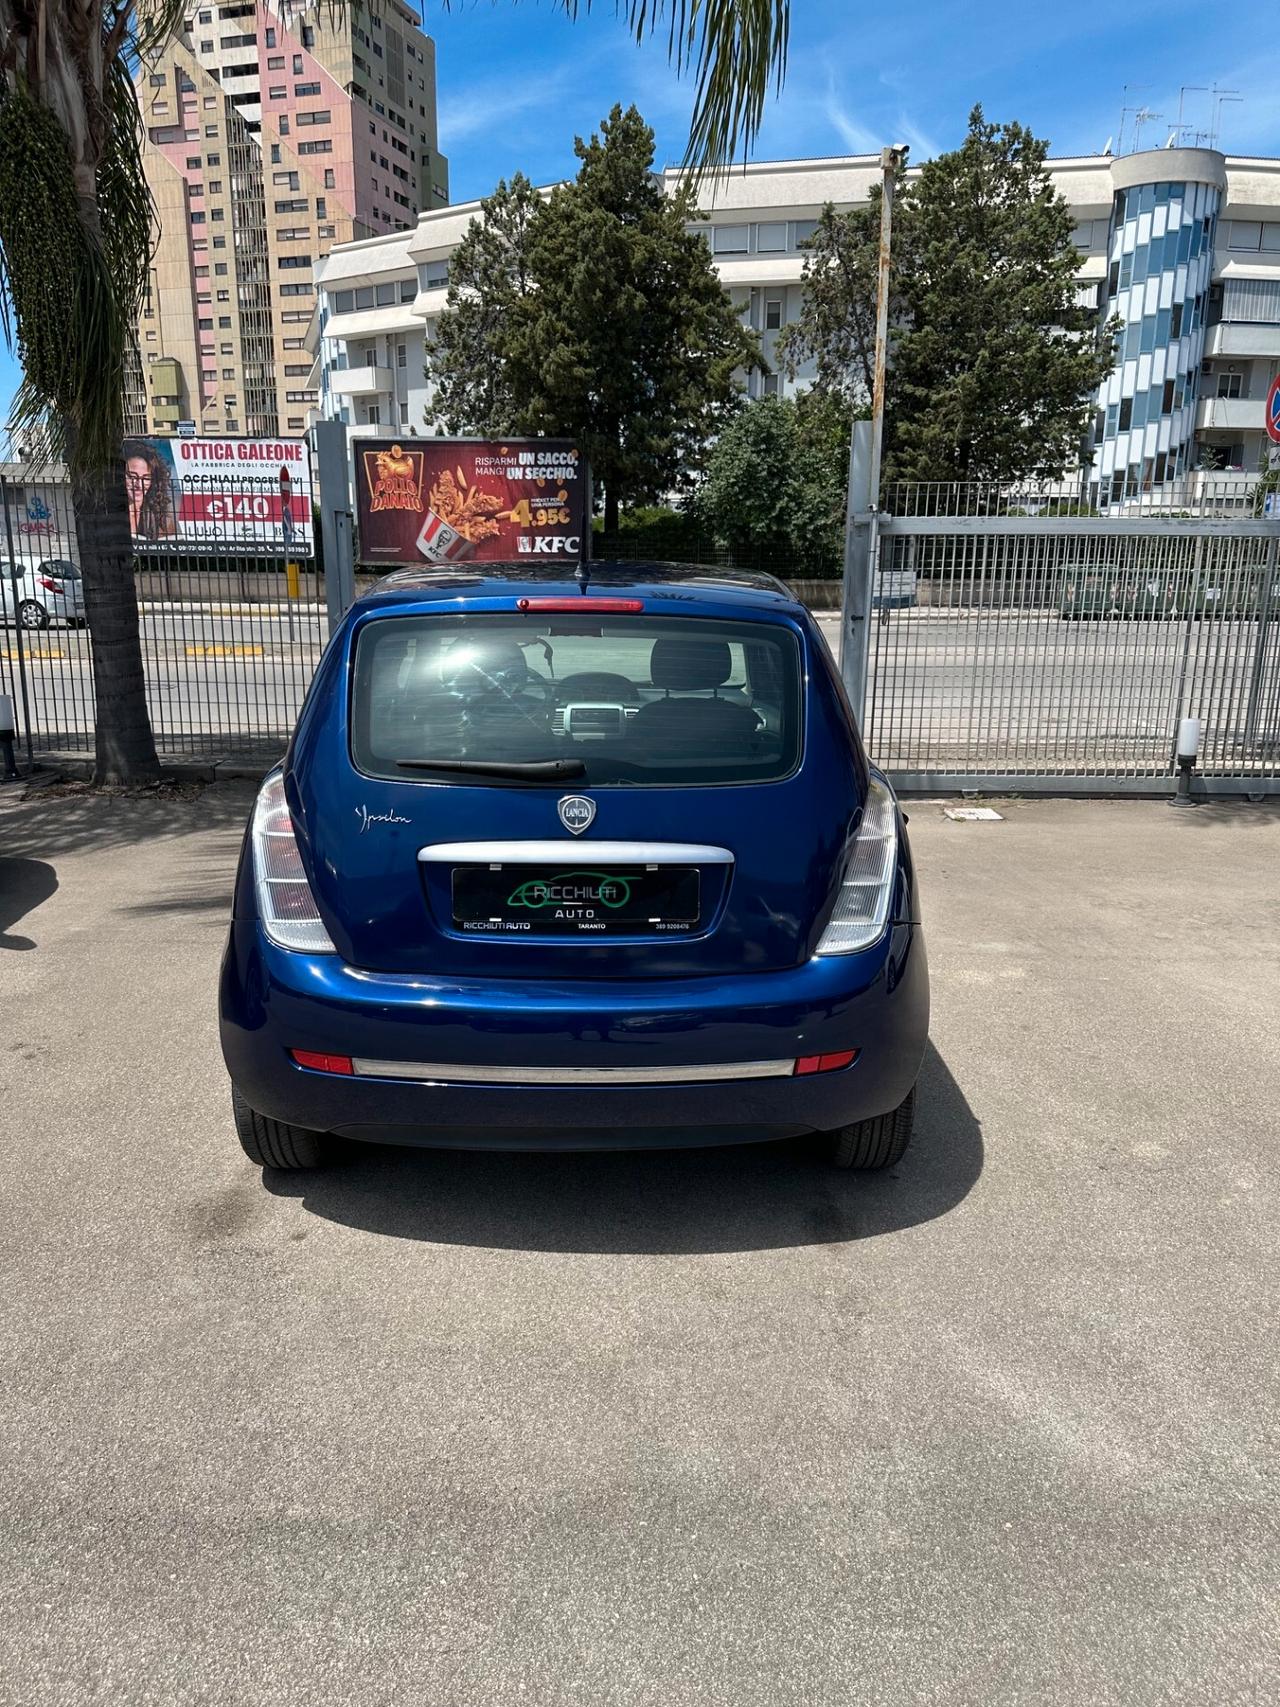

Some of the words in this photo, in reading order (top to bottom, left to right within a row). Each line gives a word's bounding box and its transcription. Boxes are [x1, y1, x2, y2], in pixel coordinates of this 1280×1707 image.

[181, 443, 235, 460] OTTICA
[237, 444, 303, 461] GALEONE
[475, 457, 517, 466] RISPARMI
[518, 452, 535, 465] UN
[183, 474, 240, 484] OCCHIALI
[242, 476, 303, 485] PROGREIVI
[475, 467, 505, 476] MANGI
[506, 467, 523, 480] UN
[524, 467, 578, 480] SECCHIO.
[375, 478, 417, 496] POLLO
[206, 496, 269, 519] €140
[370, 494, 424, 512] DANAIO
[533, 536, 580, 553] KFC
[355, 804, 412, 833] Ypsilon
[565, 807, 589, 817] LANCIA
[534, 886, 617, 899] RICCHIUTI
[554, 909, 595, 919] AUTO
